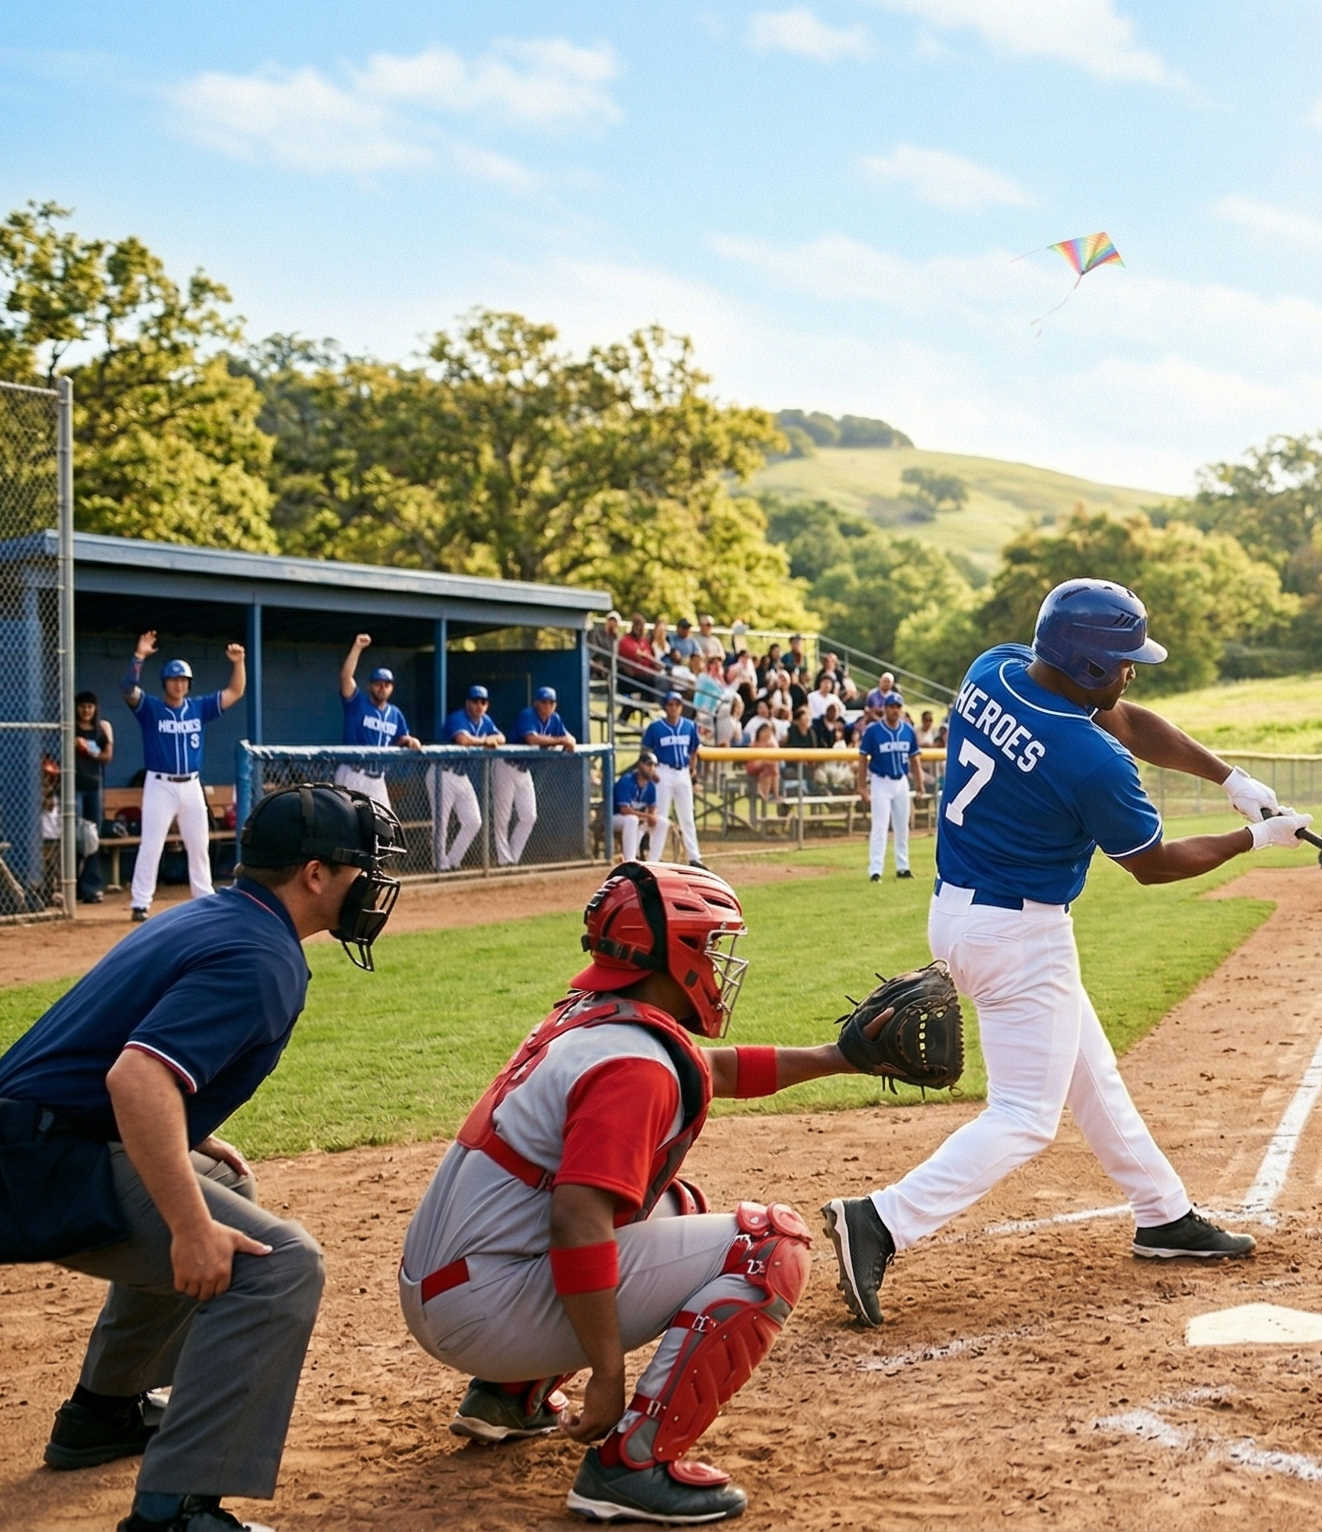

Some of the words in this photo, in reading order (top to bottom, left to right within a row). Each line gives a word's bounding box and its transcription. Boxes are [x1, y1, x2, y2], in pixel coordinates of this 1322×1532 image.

[190, 732, 200, 748] 3
[955, 680, 1046, 773] HEROES
[945, 738, 996, 827] 7
